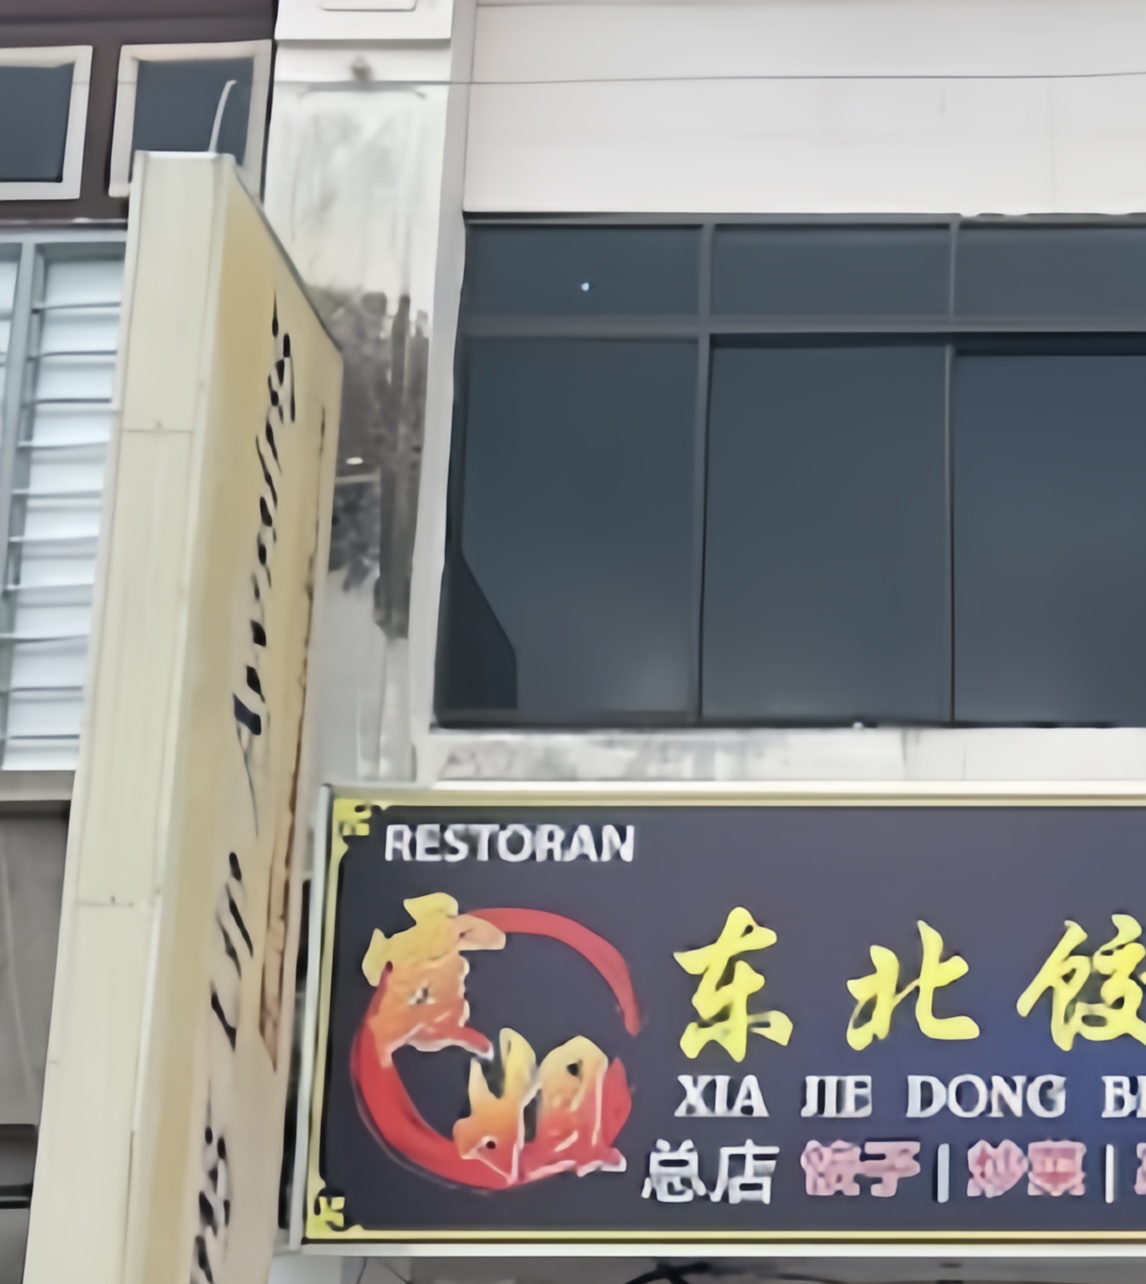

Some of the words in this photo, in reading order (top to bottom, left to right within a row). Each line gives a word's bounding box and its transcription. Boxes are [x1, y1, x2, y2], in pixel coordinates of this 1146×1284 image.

[383, 823, 635, 862] RESTORAN
[673, 1074, 769, 1117] XIA
[800, 1074, 872, 1117] JIE
[905, 1073, 1066, 1118] DONG
[641, 1138, 780, 1204] 总店
